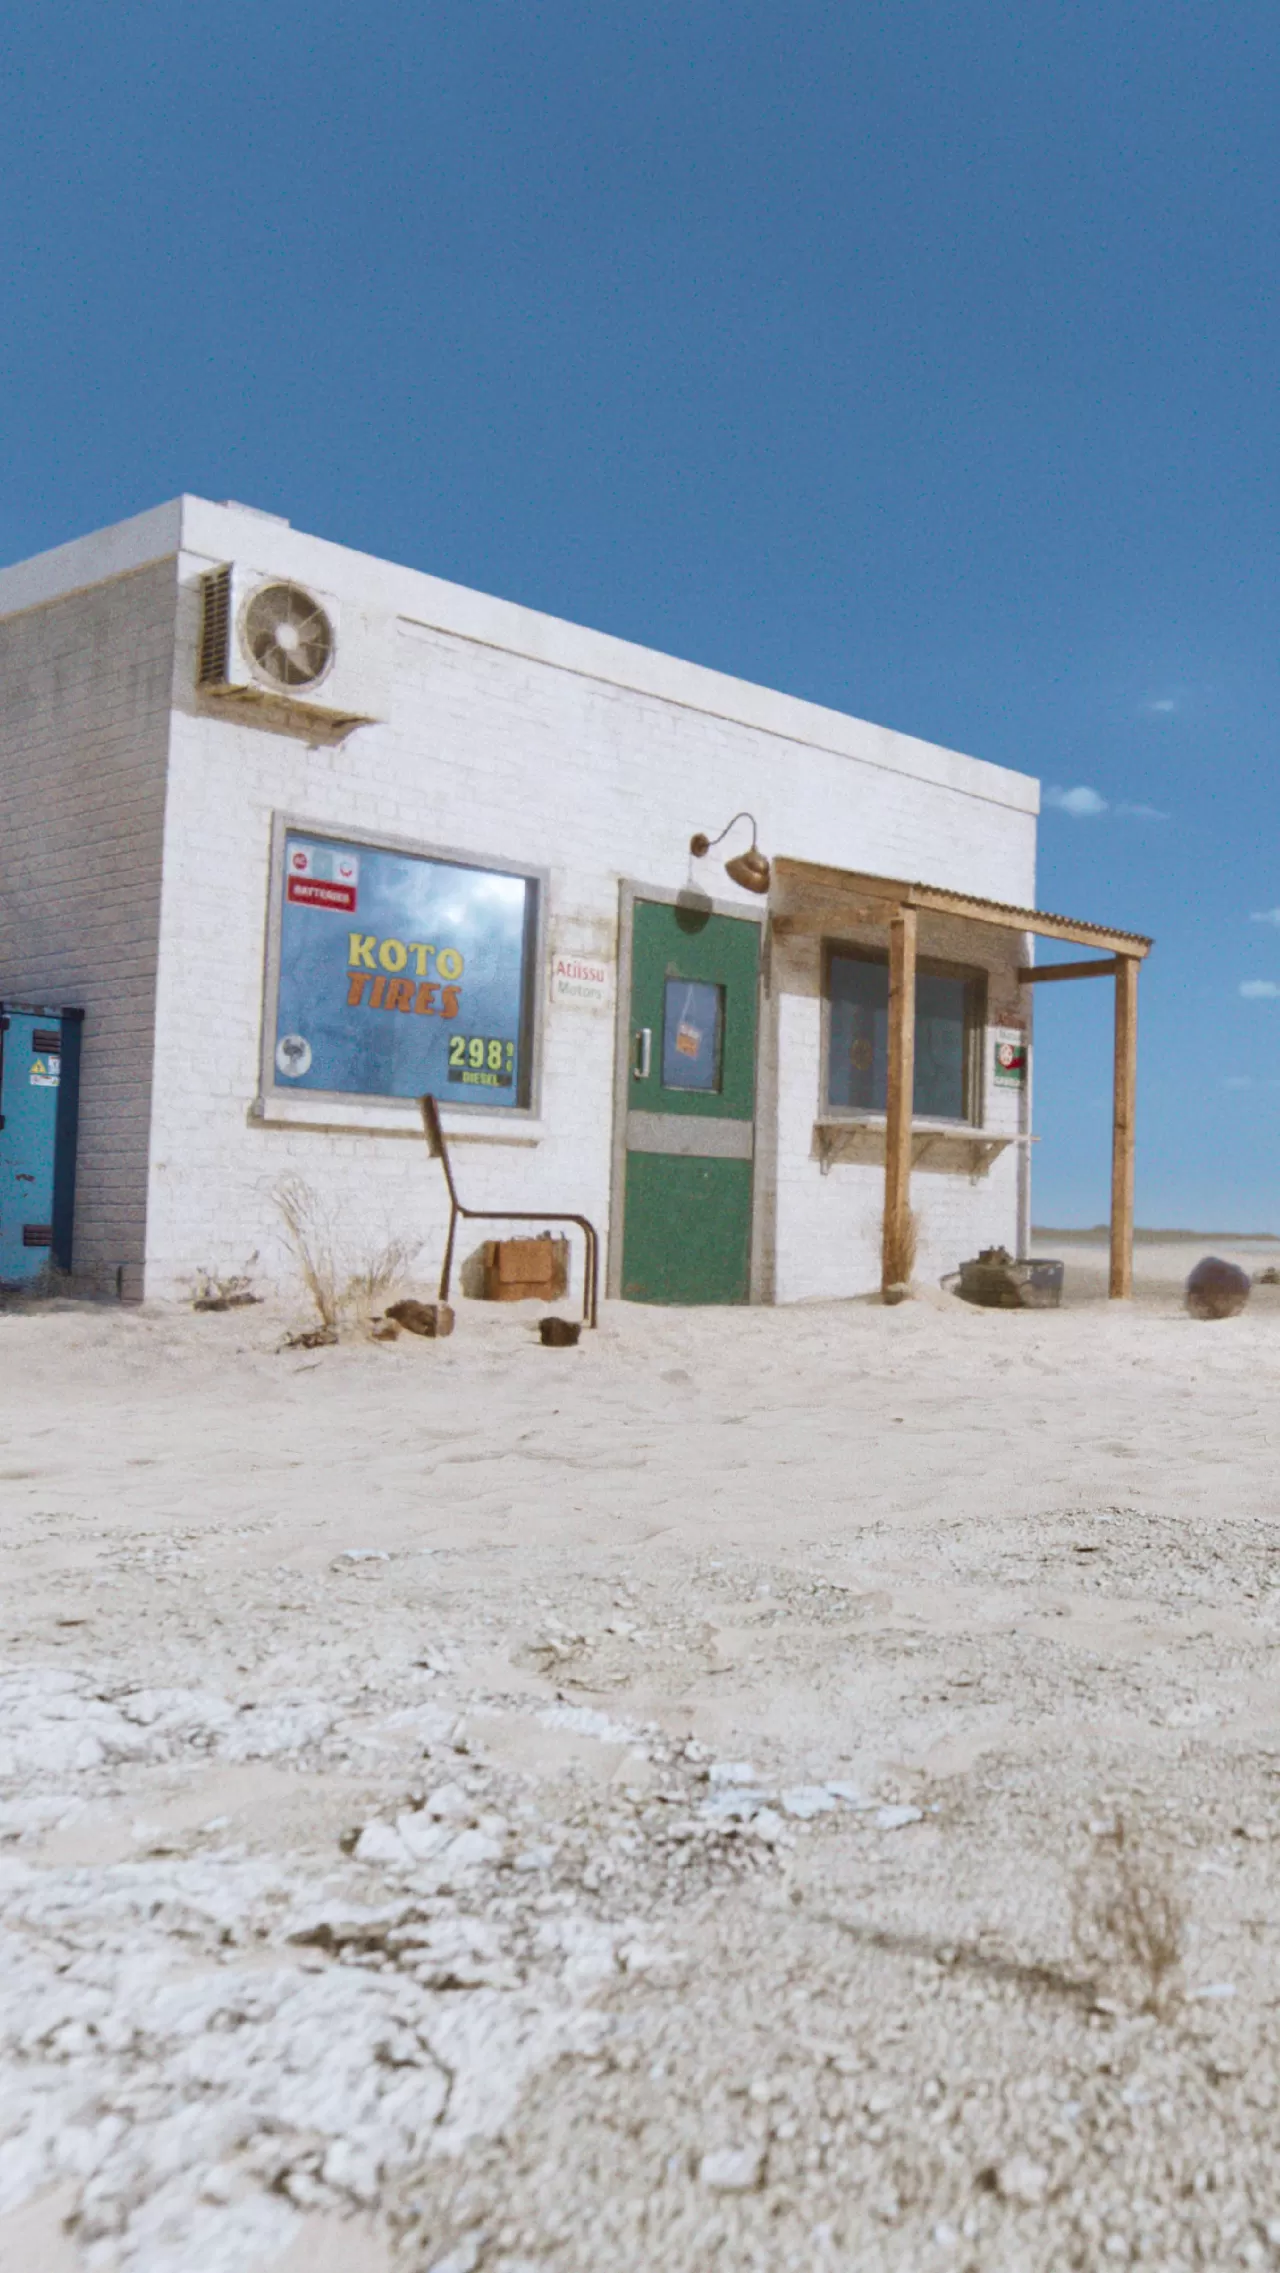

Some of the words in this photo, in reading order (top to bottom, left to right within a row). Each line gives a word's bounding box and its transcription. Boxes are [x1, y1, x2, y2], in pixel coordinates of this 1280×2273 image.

[347, 932, 463, 980] KOTO
[346, 971, 462, 1019] TIRES
[462, 1071, 499, 1087] DIESEL
